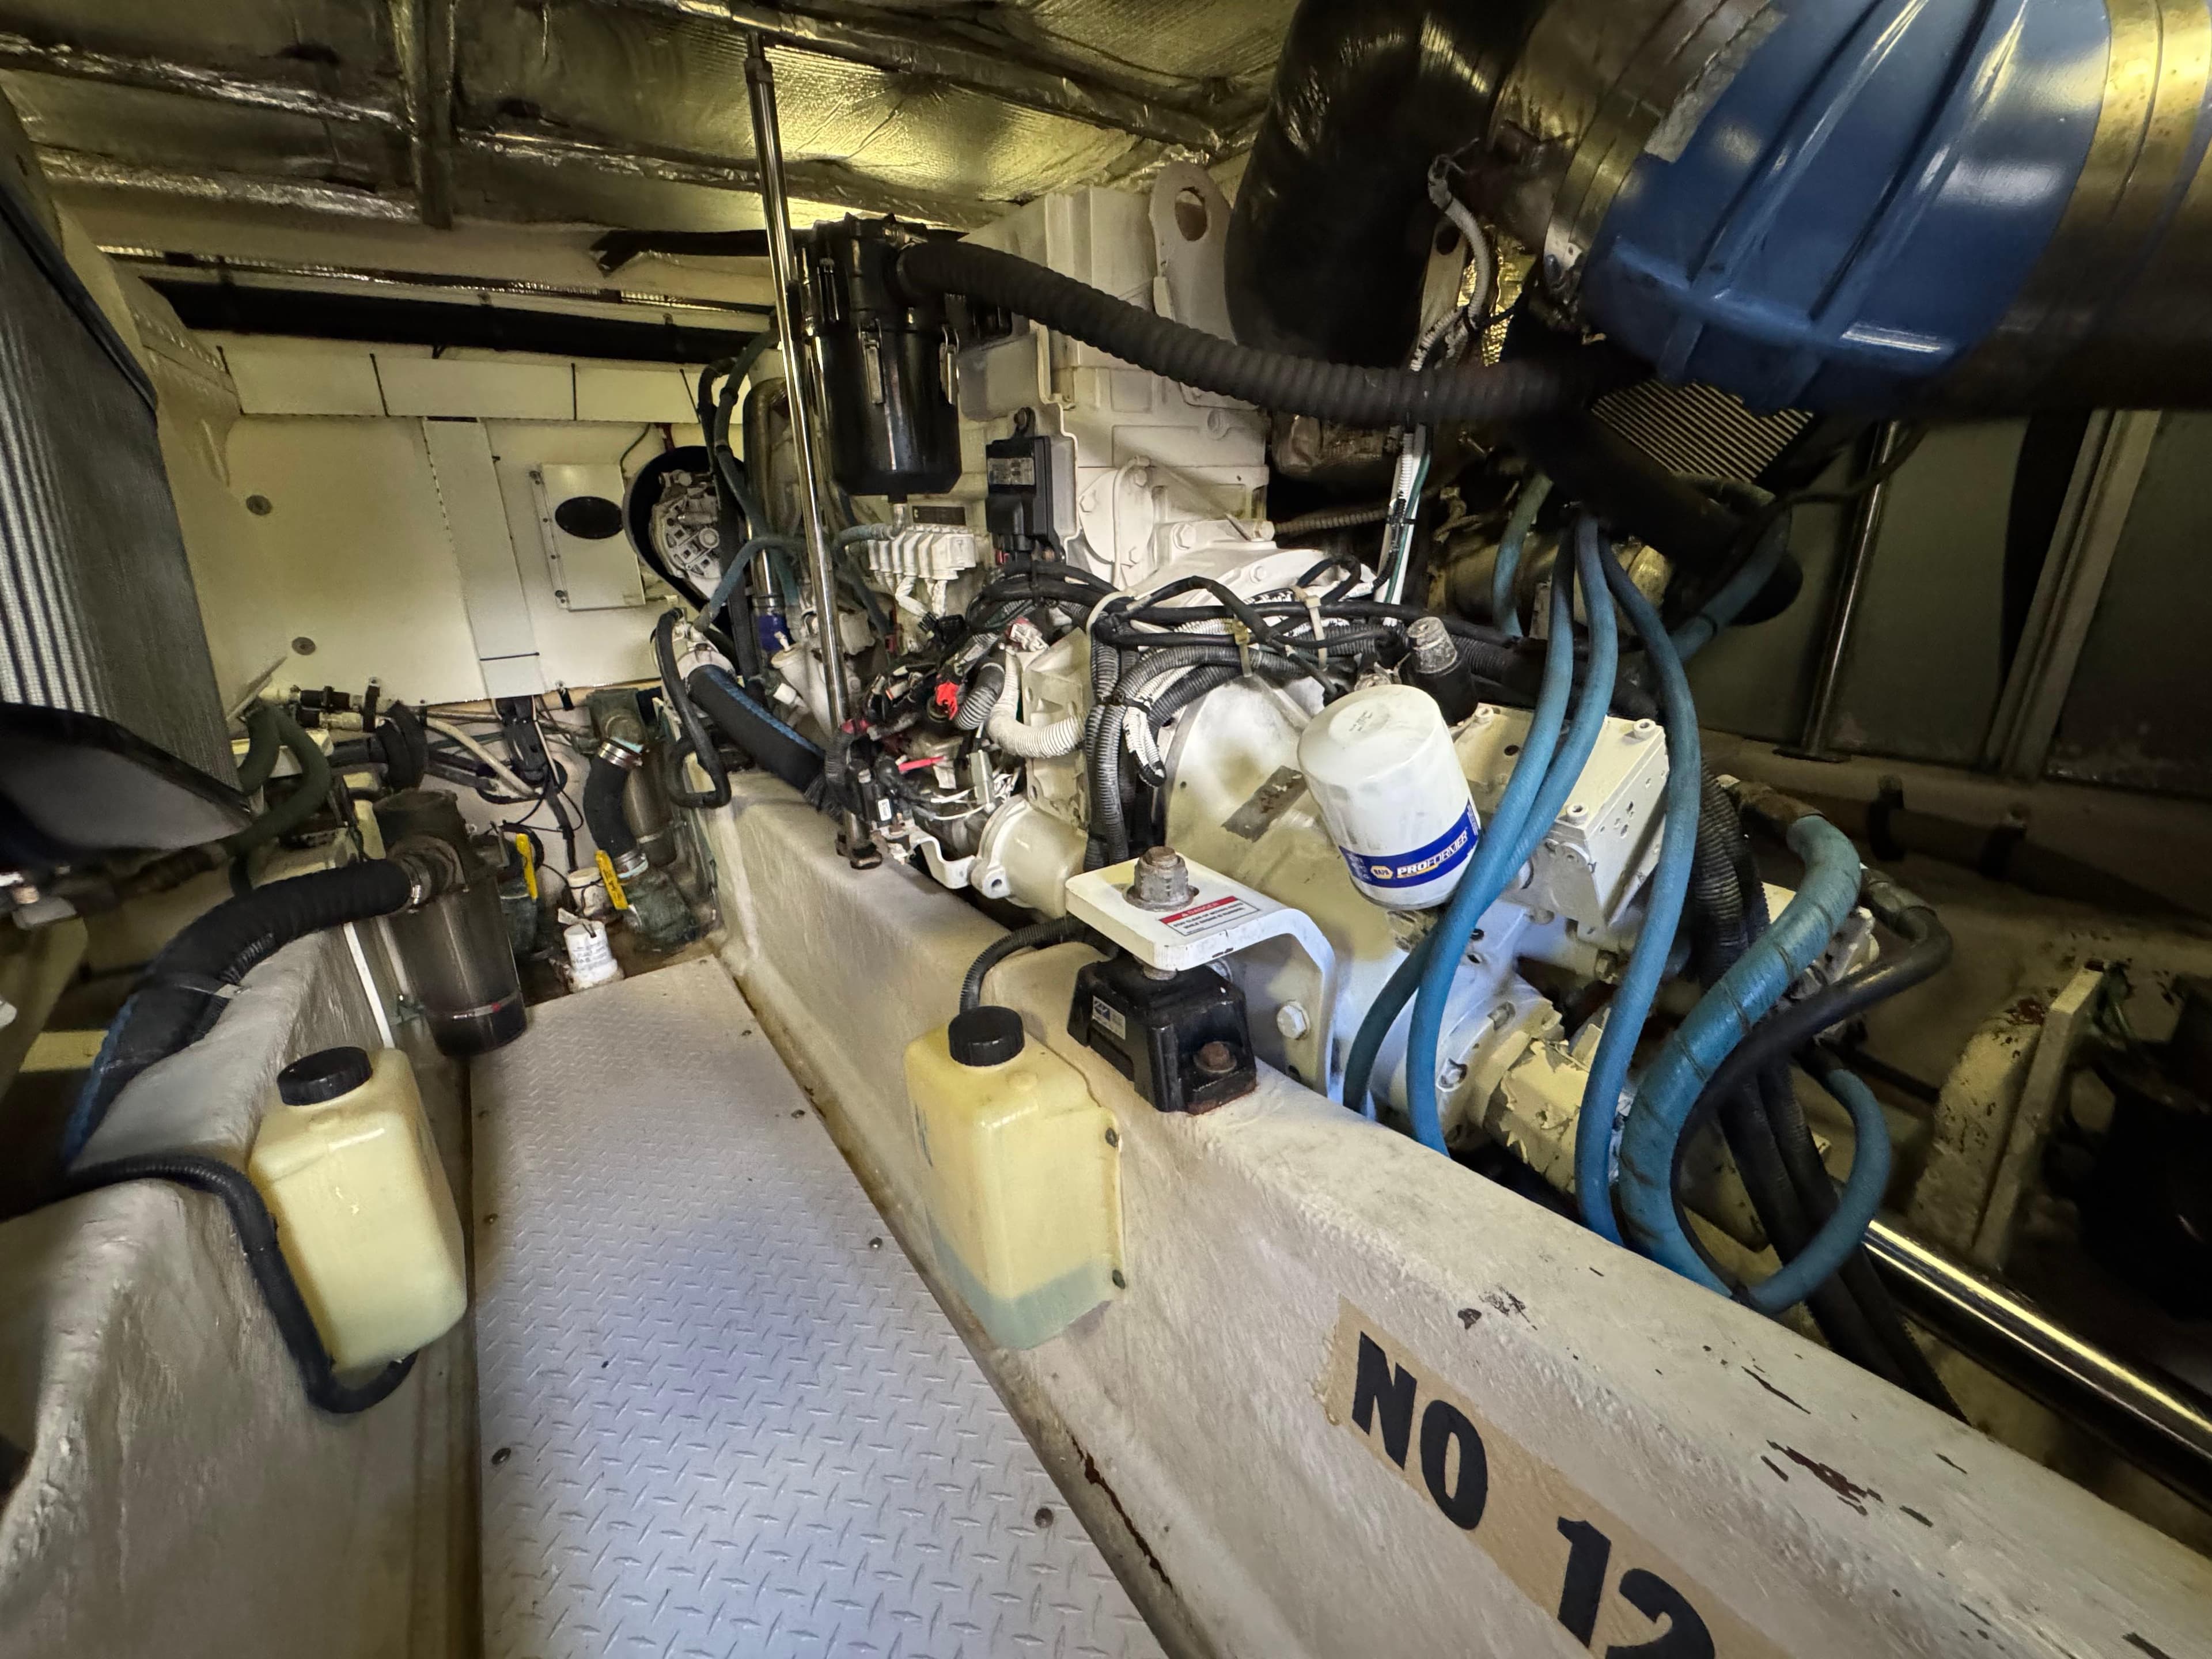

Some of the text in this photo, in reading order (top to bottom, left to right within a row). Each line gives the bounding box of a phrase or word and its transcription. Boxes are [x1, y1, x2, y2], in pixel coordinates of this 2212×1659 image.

[1396, 829, 1468, 876] PROFORMER
[1187, 902, 1219, 915] DANGER
[1352, 1331, 1716, 1659] NO 12
